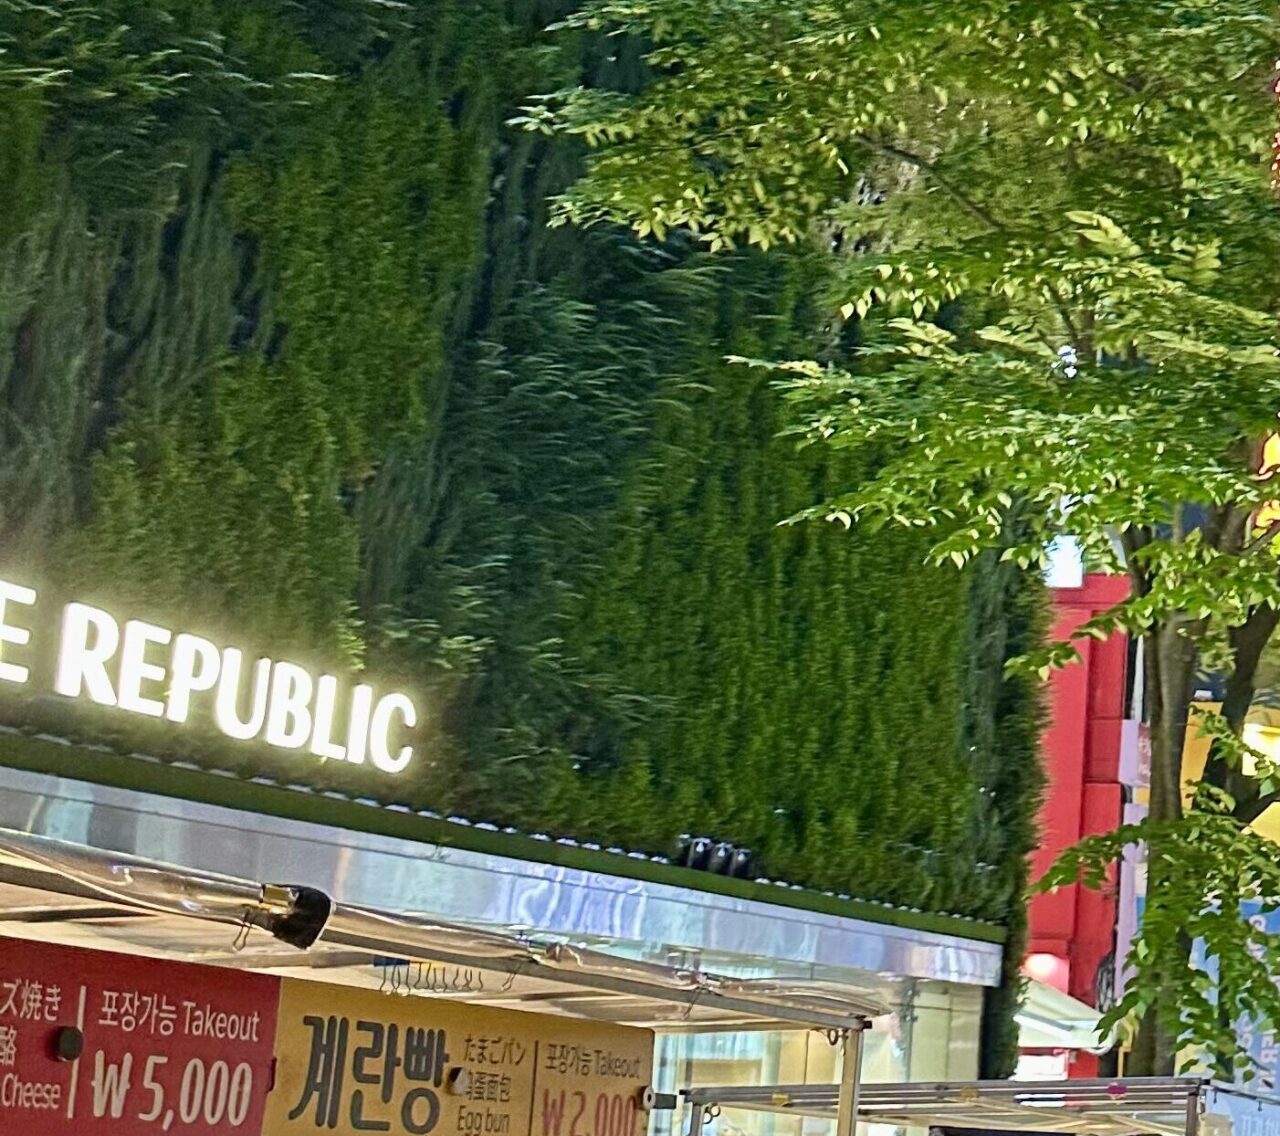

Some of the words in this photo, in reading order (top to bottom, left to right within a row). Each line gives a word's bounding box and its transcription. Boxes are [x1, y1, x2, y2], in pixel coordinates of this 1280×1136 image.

[54, 601, 418, 774] REPUBLIC
[99, 990, 178, 1037] 포장가능
[182, 1001, 261, 1043] Takeout
[463, 1034, 527, 1066] たまごパン
[545, 1043, 592, 1076] 포장가능
[594, 1049, 641, 1080] Takeout
[2, 1072, 62, 1110] Cheese
[138, 1055, 253, 1132] 5,000
[288, 1015, 450, 1136] 계란빵
[484, 1108, 510, 1134] bun
